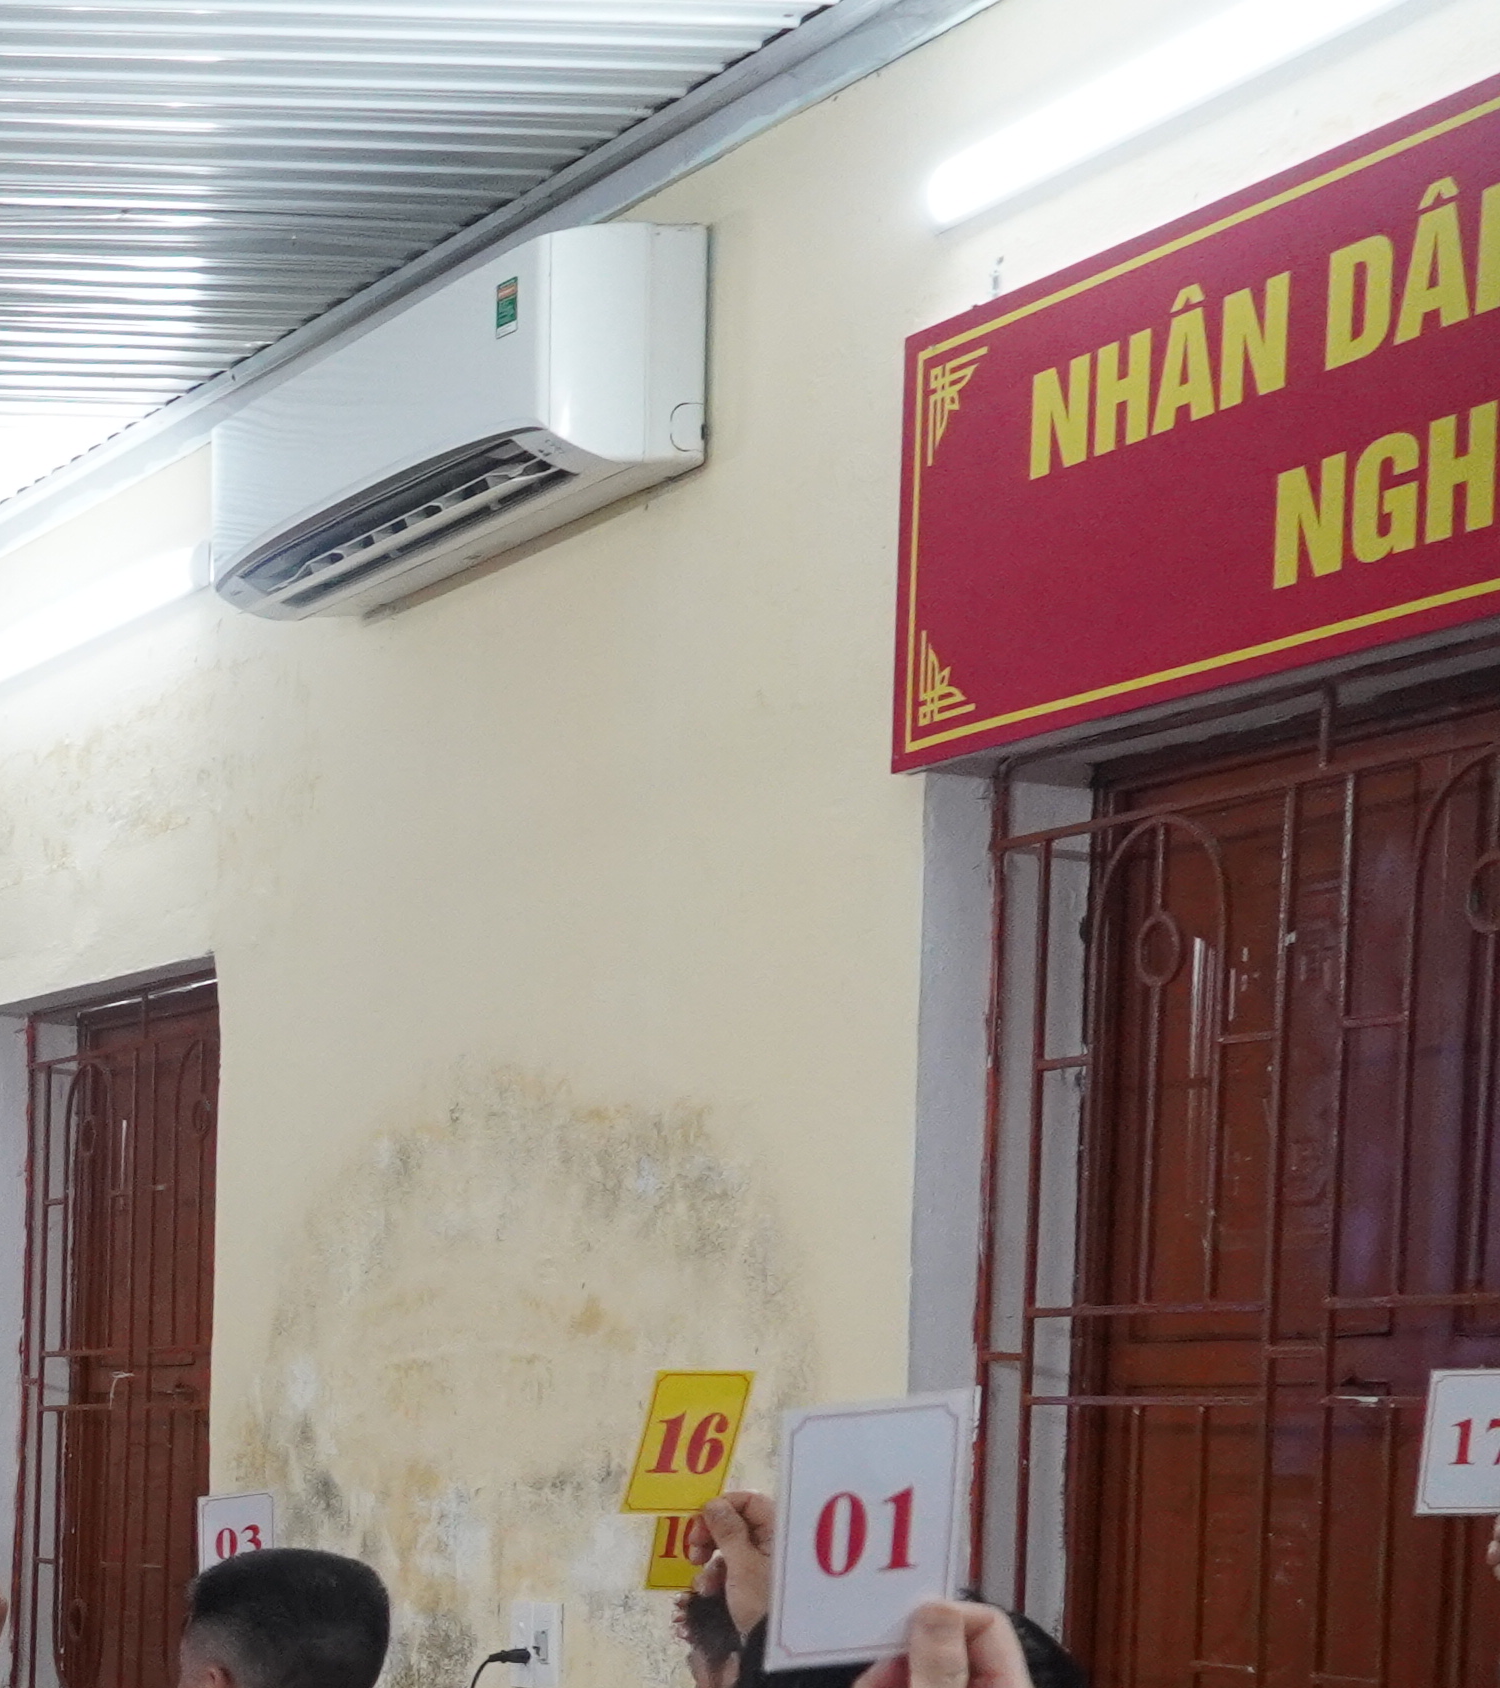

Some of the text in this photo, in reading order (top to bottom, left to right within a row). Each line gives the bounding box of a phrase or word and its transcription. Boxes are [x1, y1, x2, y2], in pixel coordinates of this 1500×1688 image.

[1030, 270, 1290, 480] NHÂN
[644, 1410, 730, 1475] 16
[216, 1523, 262, 1556] 03
[815, 1486, 918, 1578] 01
